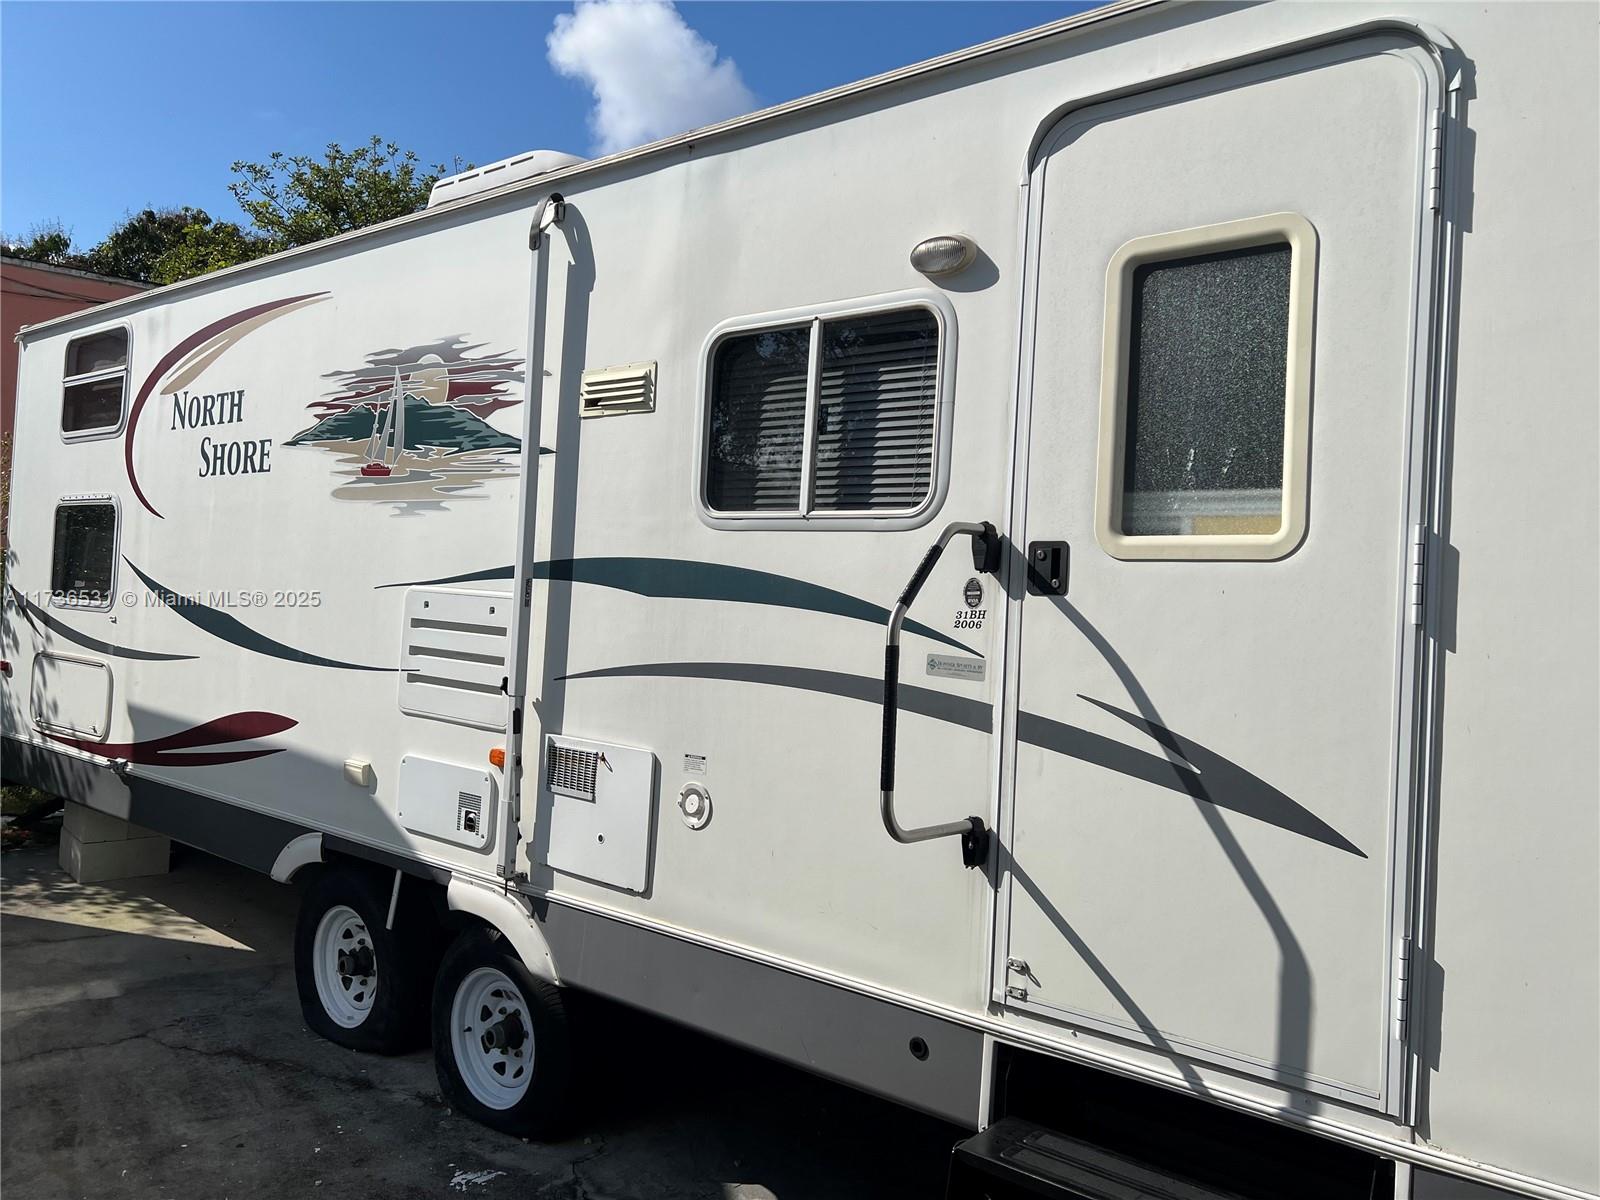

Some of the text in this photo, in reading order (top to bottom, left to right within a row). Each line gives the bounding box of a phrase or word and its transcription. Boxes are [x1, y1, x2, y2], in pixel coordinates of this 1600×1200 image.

[171, 390, 245, 430] NORTH
[199, 437, 272, 477] SHORE
[953, 620, 982, 629] 2006
[955, 610, 987, 620] 31BH
